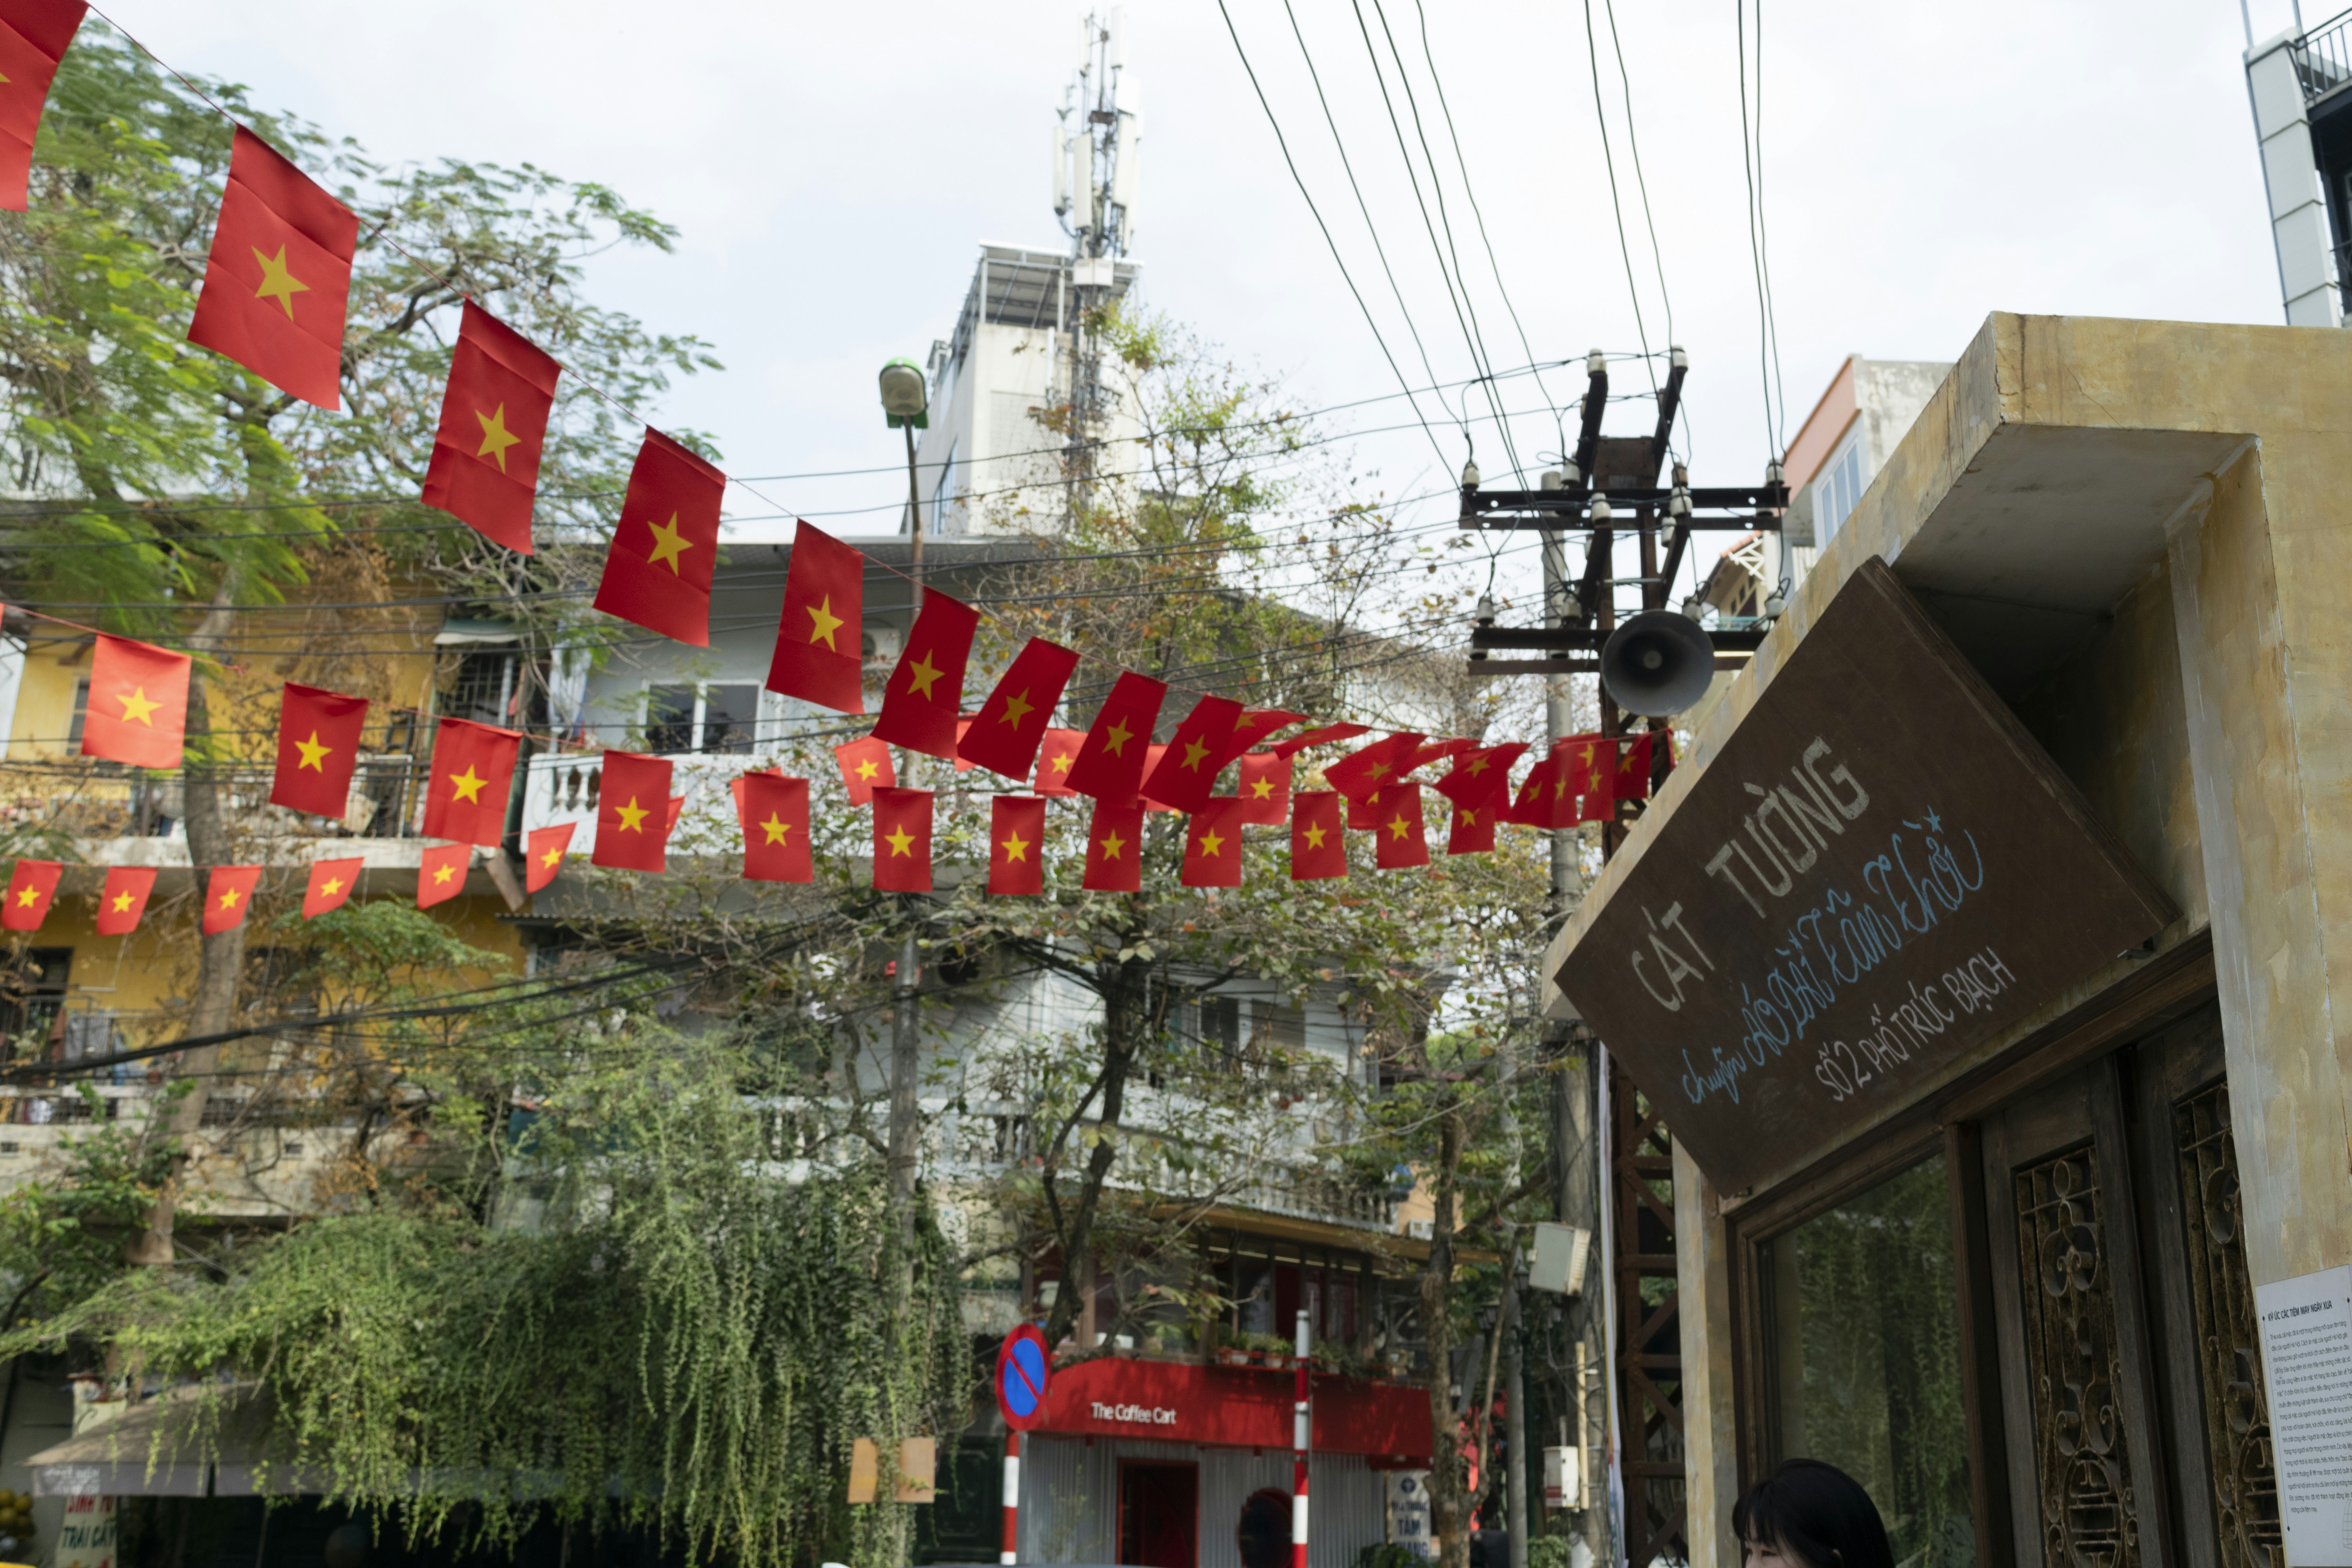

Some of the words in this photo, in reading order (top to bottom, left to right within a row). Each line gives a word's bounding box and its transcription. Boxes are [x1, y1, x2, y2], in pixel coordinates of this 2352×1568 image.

[1632, 901, 1715, 1012] CÁT
[1704, 735, 1869, 918] TƯỜNG
[1741, 982, 1790, 1066] ÁO
[1768, 929, 1835, 1040] DÀI
[1863, 805, 1984, 934] Thời
[1942, 946, 2016, 1014] BẠCH
[1858, 1003, 1910, 1074] PHỐ
[1889, 980, 1955, 1050] TRÚC
[1815, 1042, 1854, 1102] SỐ
[1833, 1040, 1872, 1089] 2
[2281, 1309, 2289, 1318] CÁC
[2300, 1305, 2309, 1314] MAY
[2311, 1302, 2322, 1312] NGÀY
[1091, 1402, 1114, 1420] The
[1115, 1403, 1151, 1423] Coffee
[1152, 1406, 1176, 1425] Cart
